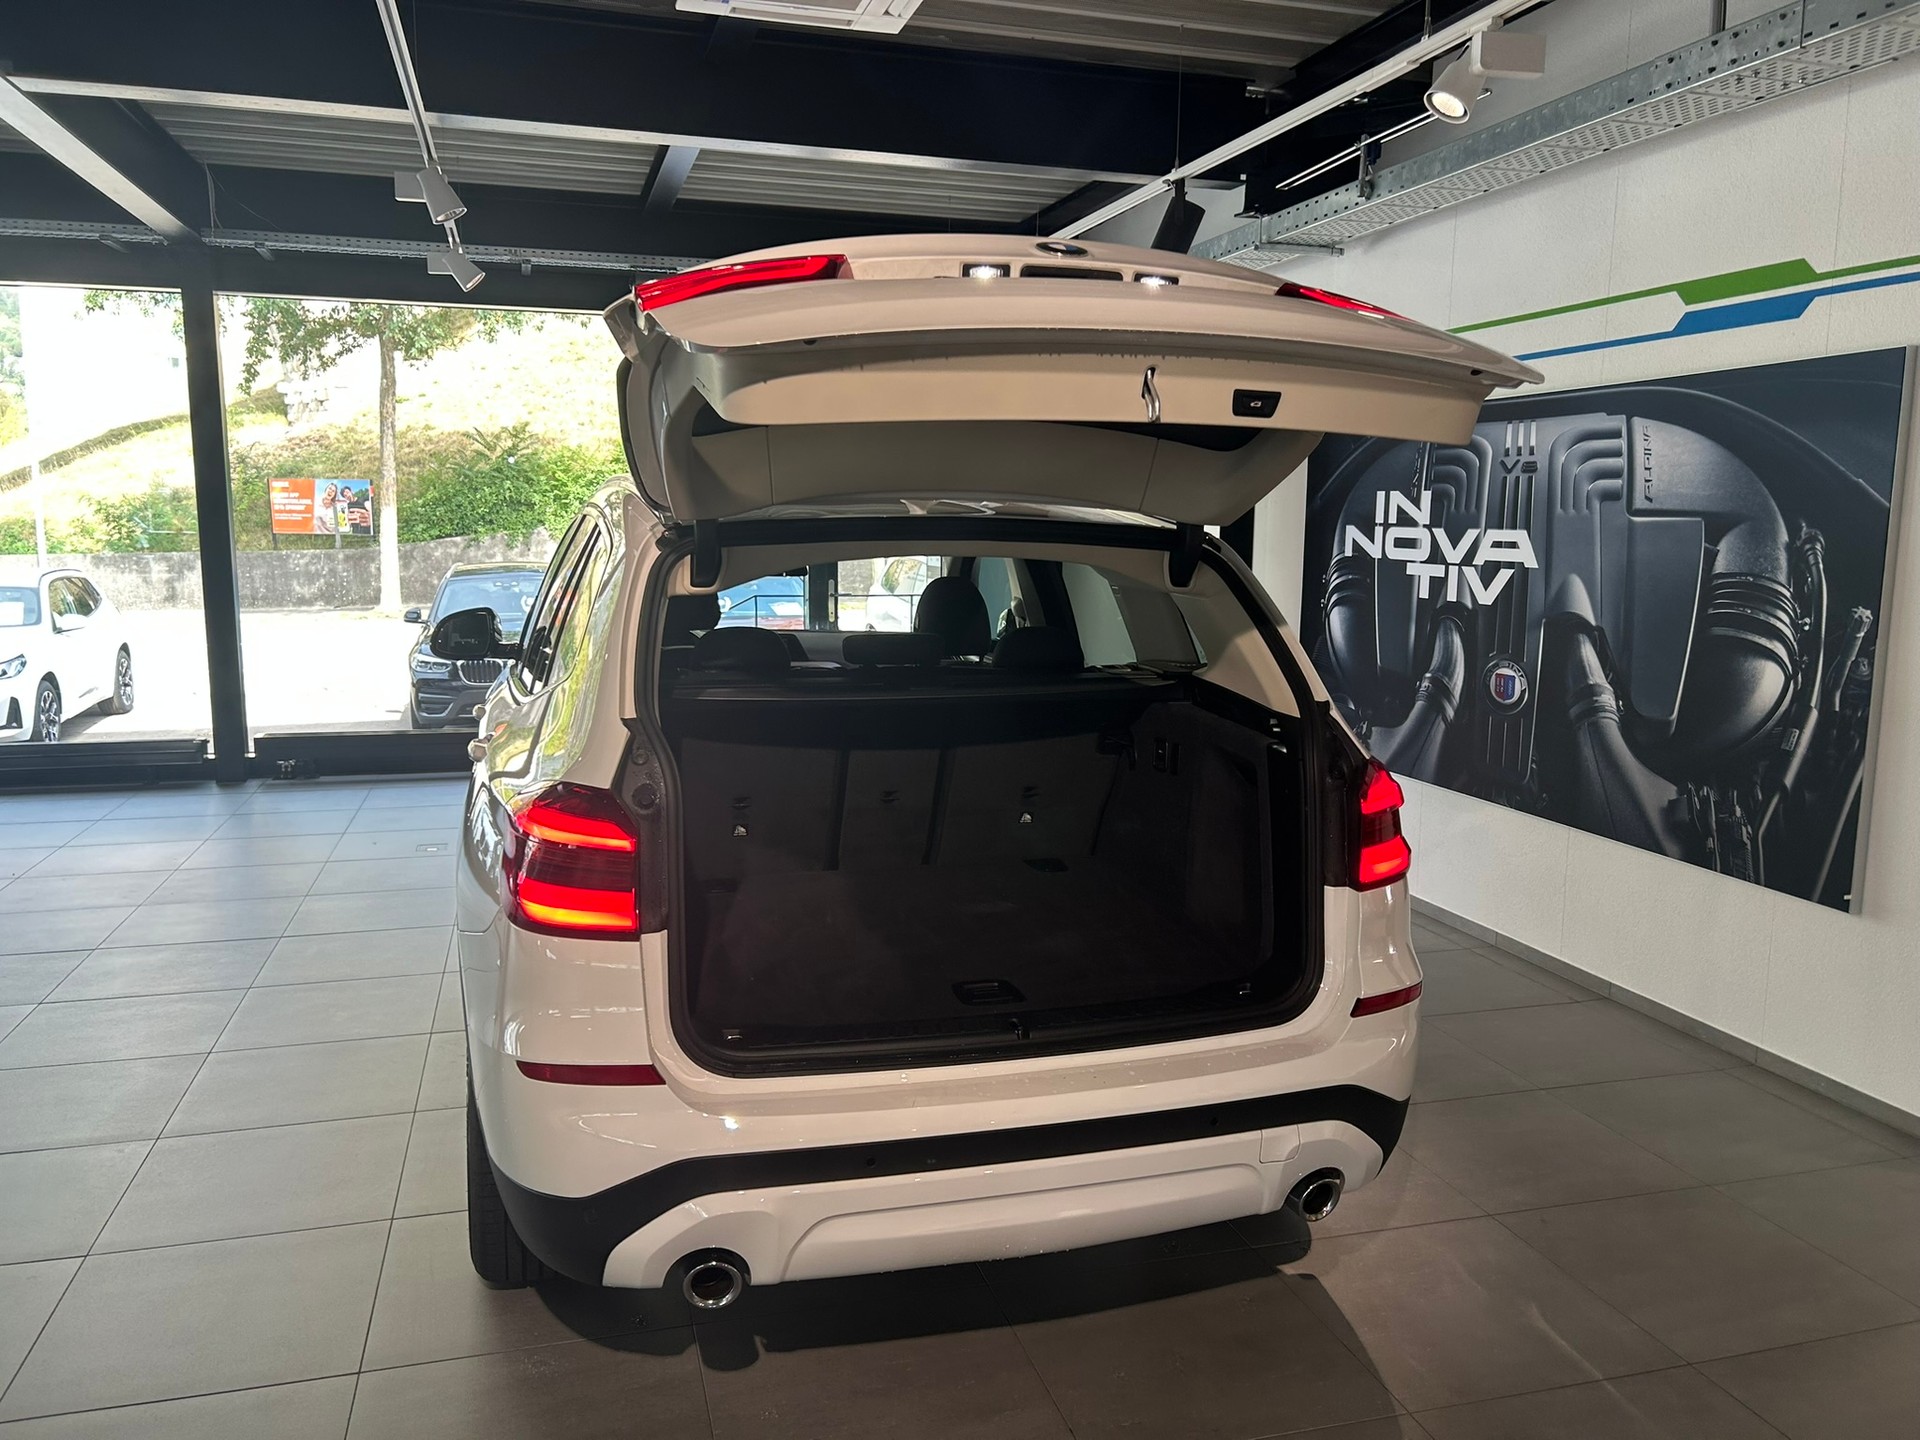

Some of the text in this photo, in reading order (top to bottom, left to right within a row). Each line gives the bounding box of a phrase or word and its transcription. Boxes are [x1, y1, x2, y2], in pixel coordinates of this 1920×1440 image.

[1499, 458, 1539, 475] V8
[1375, 490, 1432, 525] IN
[1344, 525, 1539, 569] NOVA
[1406, 562, 1516, 606] TIV
